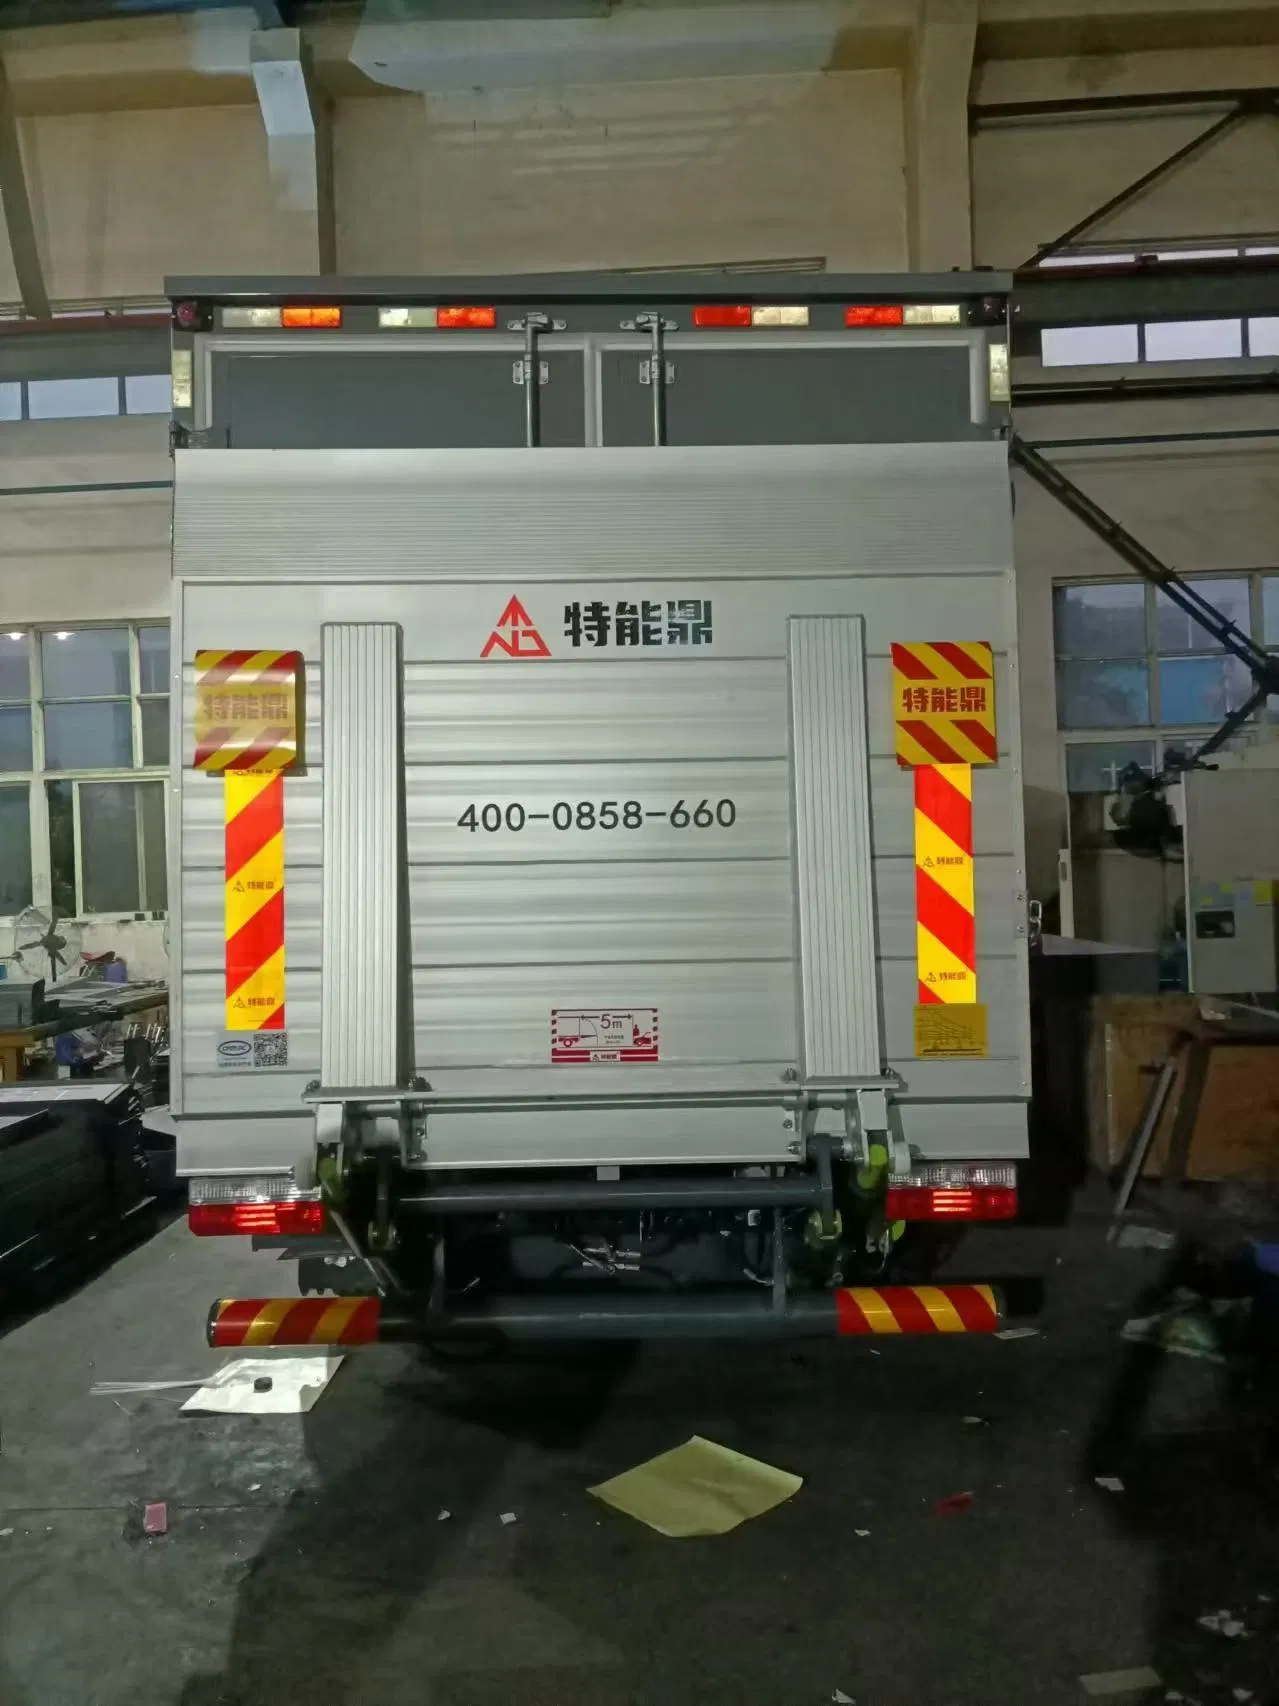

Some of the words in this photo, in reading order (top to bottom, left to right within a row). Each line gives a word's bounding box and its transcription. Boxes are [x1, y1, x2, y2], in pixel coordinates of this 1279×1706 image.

[564, 600, 713, 647] 特能鼎
[204, 693, 288, 720] 特能鼎
[902, 686, 986, 713] 特能鼎
[457, 799, 736, 832] 400-0858-660
[600, 1014, 623, 1030] 5m
